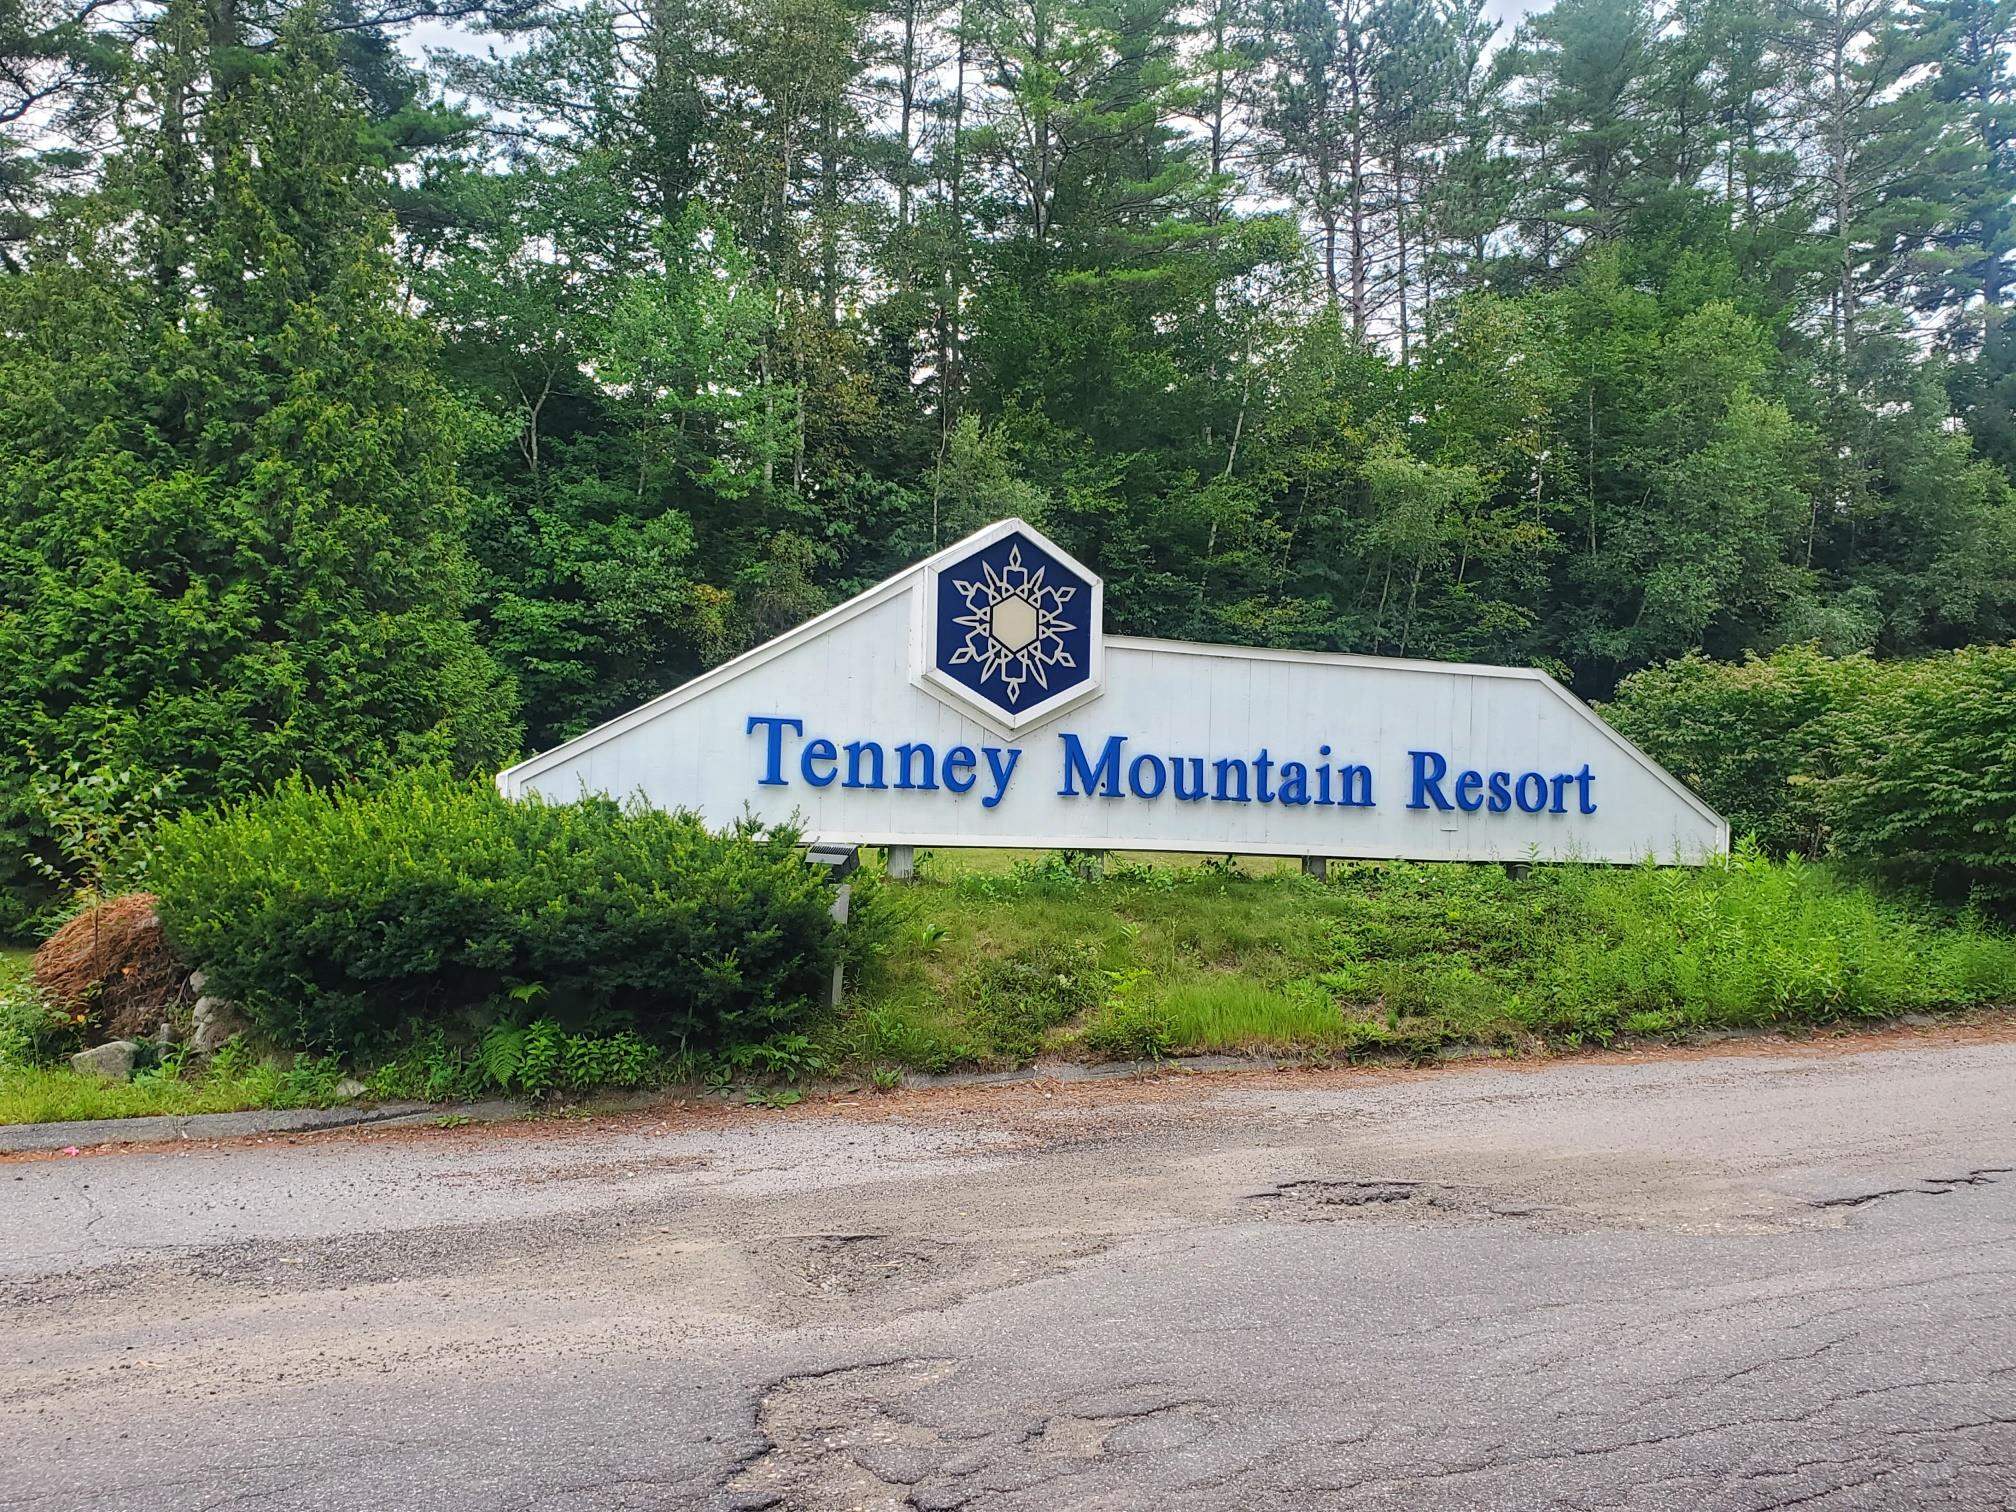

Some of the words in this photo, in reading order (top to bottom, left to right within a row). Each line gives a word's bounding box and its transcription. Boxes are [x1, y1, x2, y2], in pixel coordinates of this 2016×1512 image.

[747, 717, 1021, 808] Tenney
[1057, 733, 1376, 808] Mountain
[1406, 750, 1597, 815] Resort
